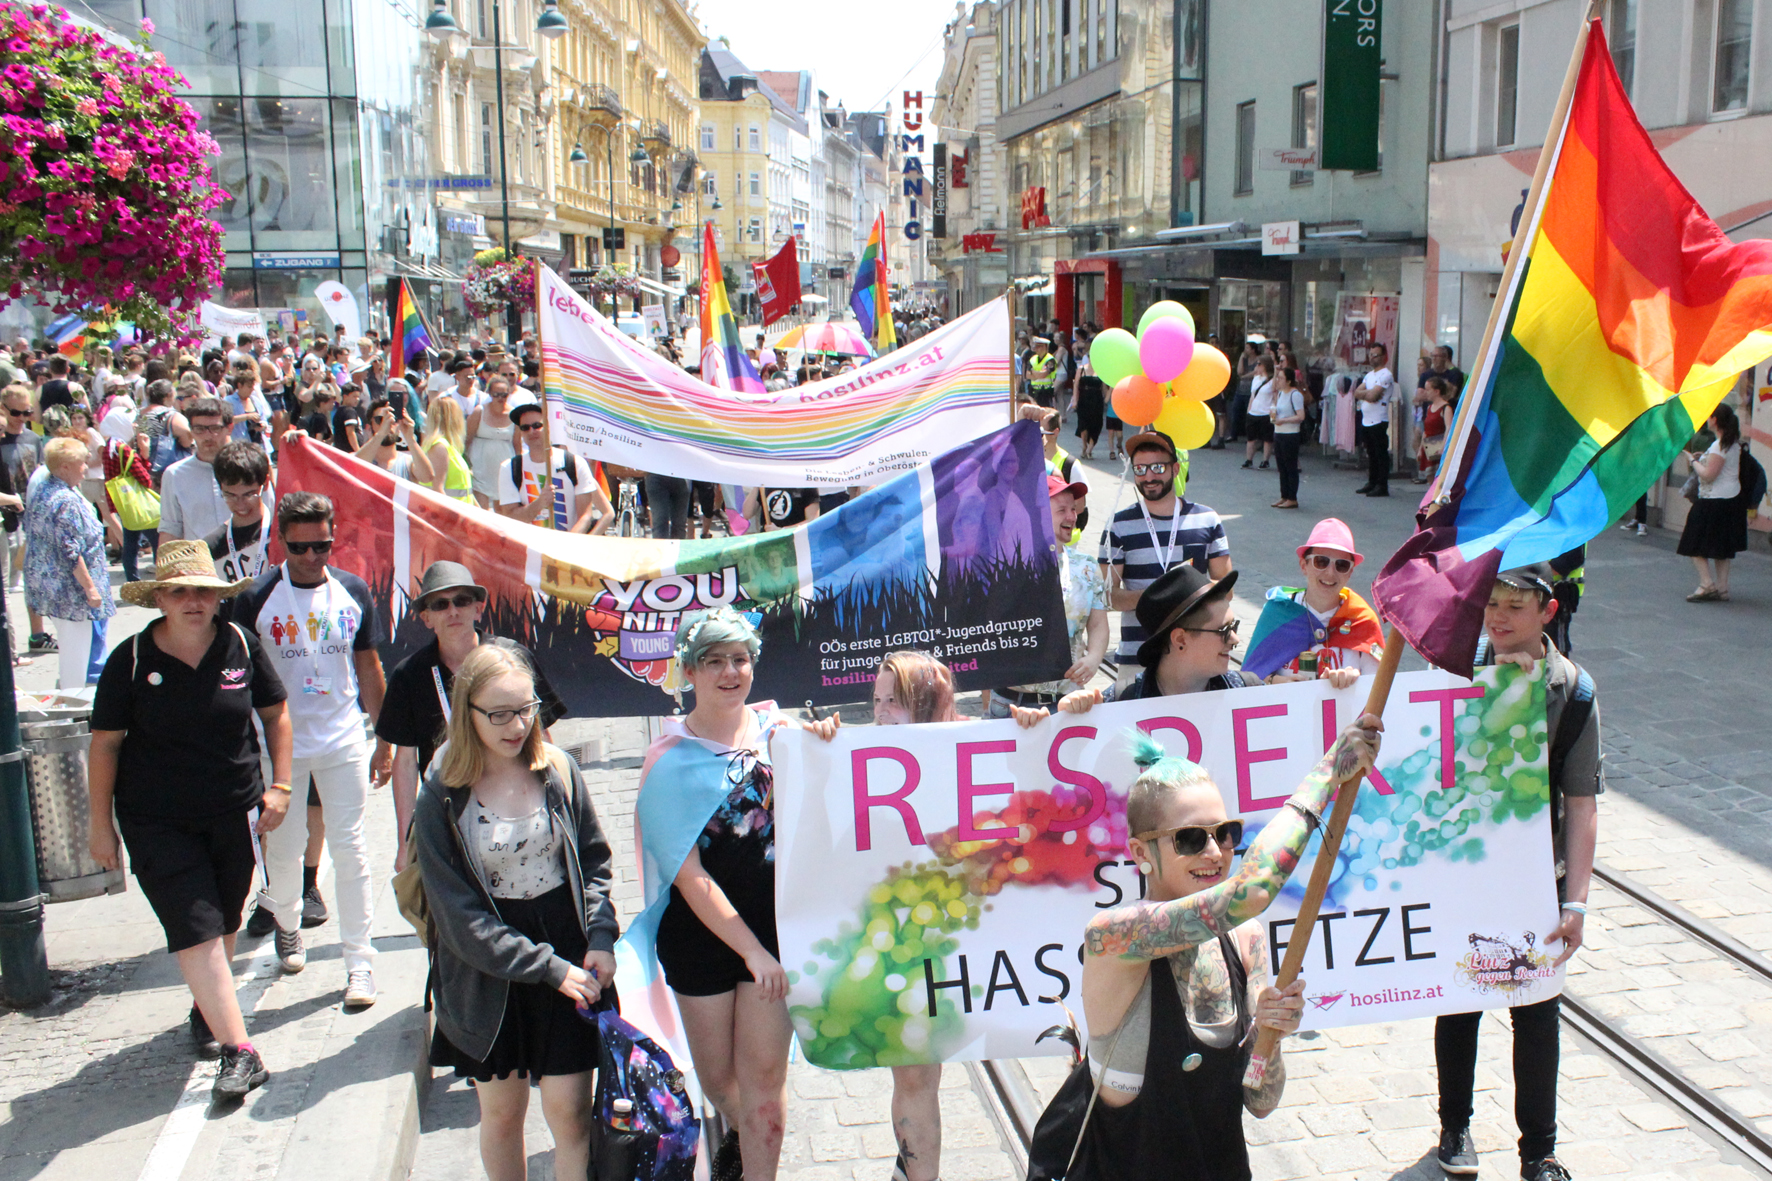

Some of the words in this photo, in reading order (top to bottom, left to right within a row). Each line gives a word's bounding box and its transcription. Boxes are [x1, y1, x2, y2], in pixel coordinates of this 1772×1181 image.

[902, 90, 924, 240] HUMANIC
[1273, 150, 1316, 168] Triumph
[453, 178, 492, 188] GROSS
[275, 259, 324, 267] ZUGANG
[548, 286, 595, 325] lebe
[602, 566, 738, 611] YOU
[281, 649, 309, 659] LOVE
[320, 644, 348, 655] LOVE
[630, 637, 670, 654] YOUNG
[820, 640, 846, 654] OÖs
[849, 637, 882, 651] erste
[820, 657, 840, 671] für
[842, 654, 882, 671] junge
[933, 646, 943, 658] &
[946, 639, 997, 657] Friends
[999, 636, 1019, 650] bis
[1022, 635, 1038, 647] 25
[1269, 903, 1437, 977] ETZE
[1467, 951, 1511, 970] Linz
[923, 943, 1085, 1018] HAS
[1476, 970, 1512, 985] gegen
[1514, 966, 1556, 980] Rechts
[1350, 984, 1444, 1007] hosilinz.at
[1111, 1080, 1138, 1092] Calvin
